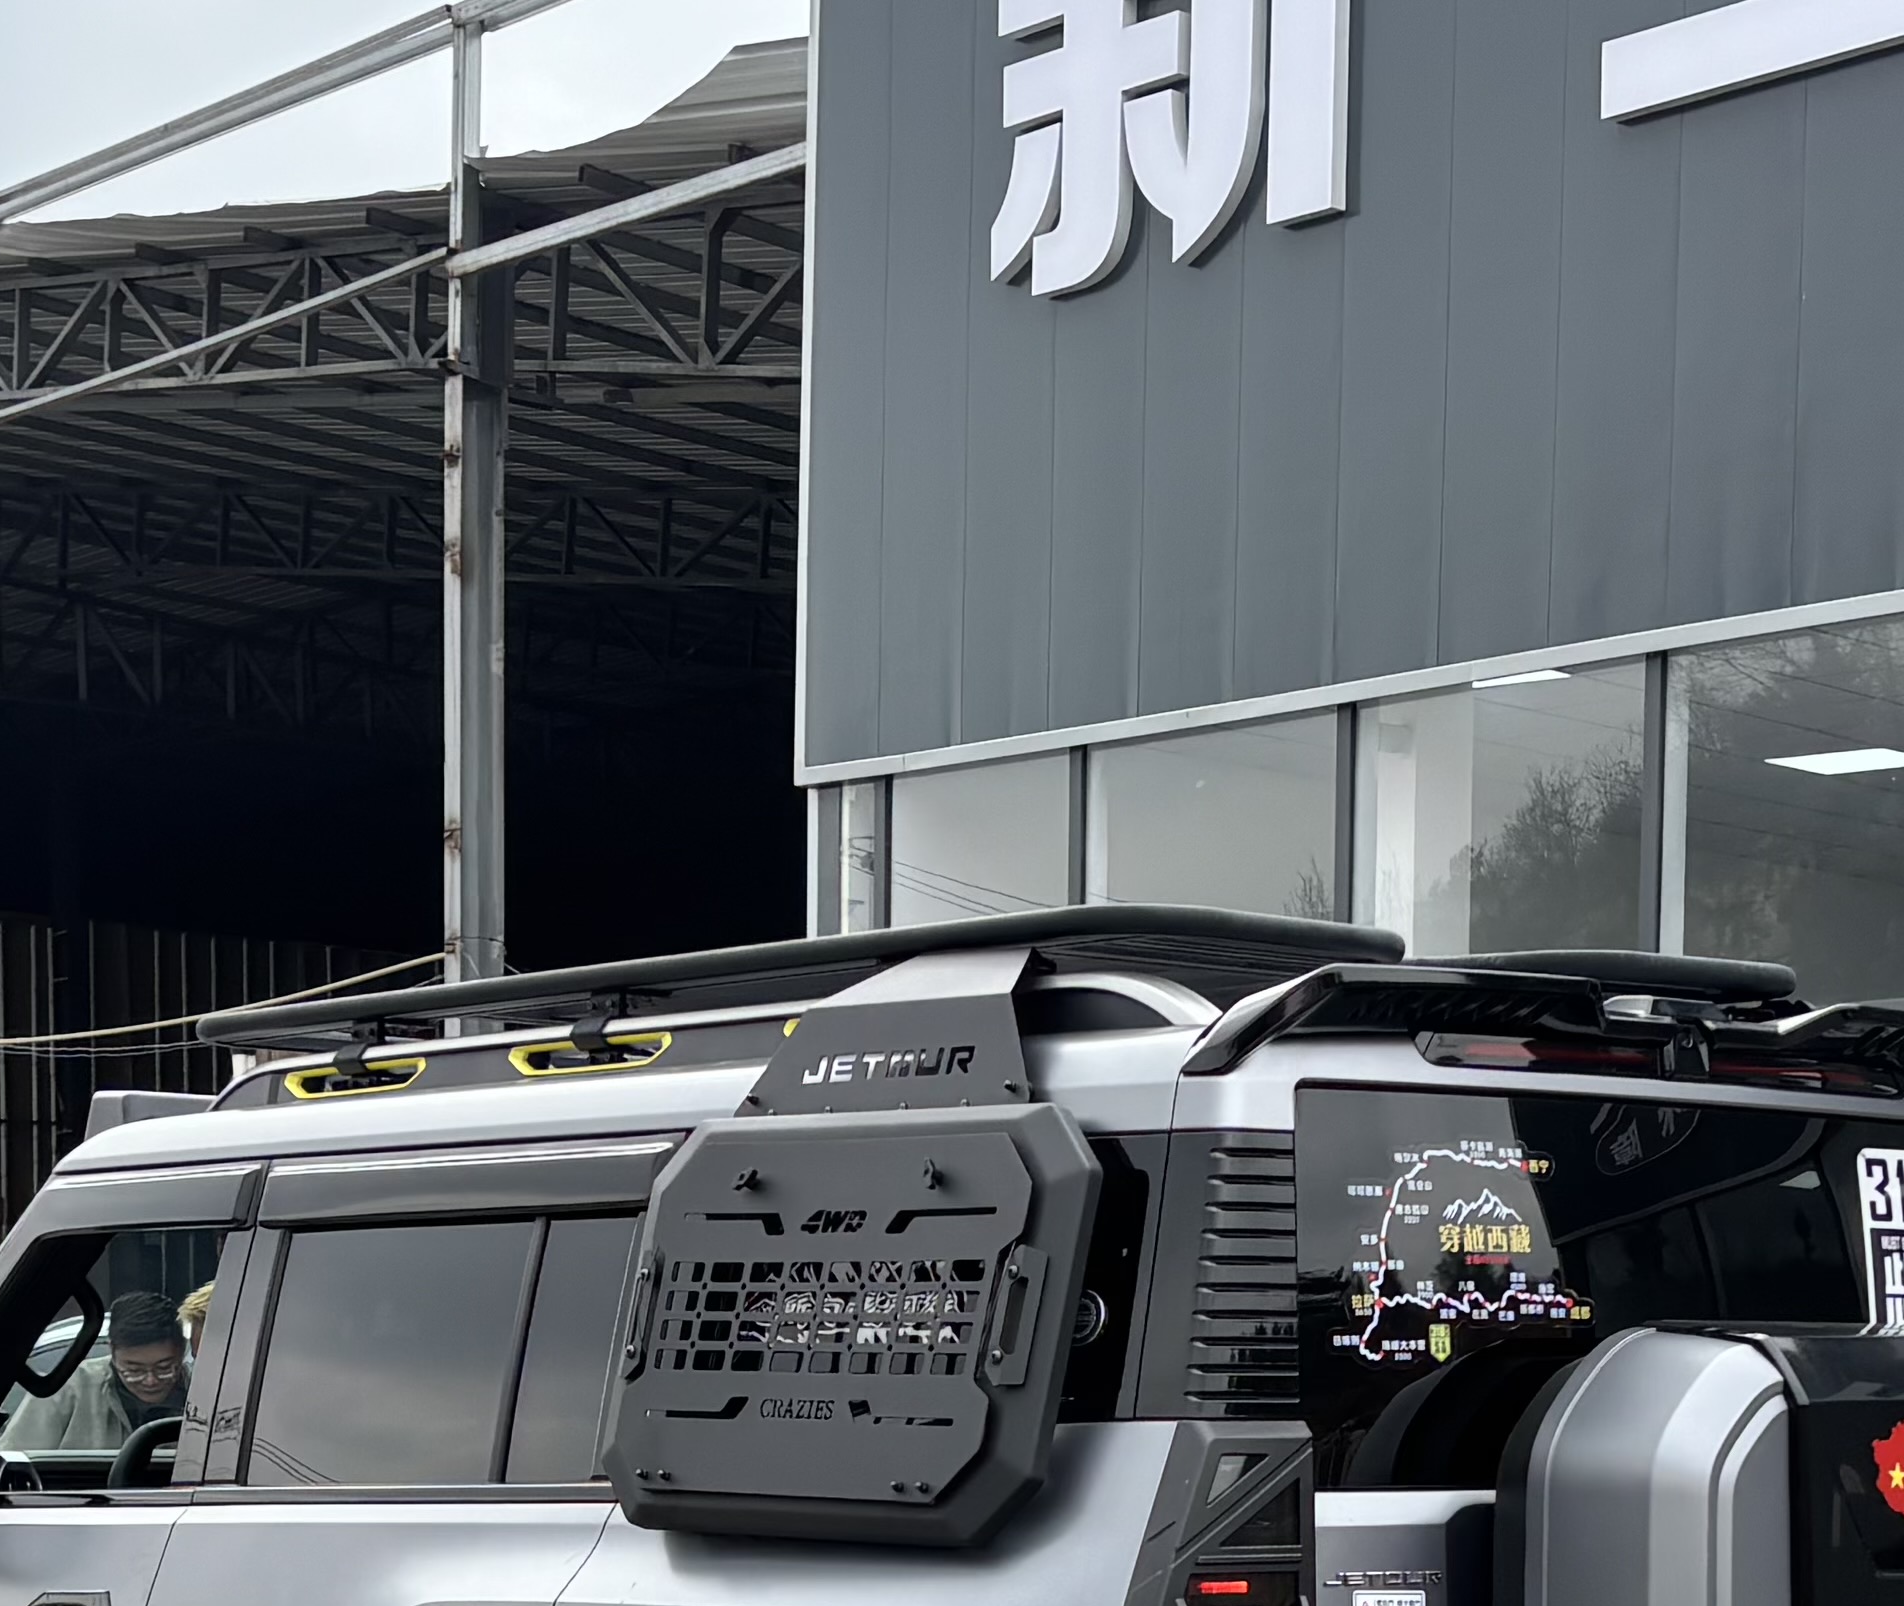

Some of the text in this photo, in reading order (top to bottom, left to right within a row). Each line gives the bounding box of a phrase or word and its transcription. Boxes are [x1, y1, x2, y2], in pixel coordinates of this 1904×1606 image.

[801, 1045, 976, 1086] JETOUR
[800, 1209, 868, 1235] 4WD
[760, 1397, 835, 1420] CRAZIES
[1324, 1570, 1443, 1587] JETOUR
